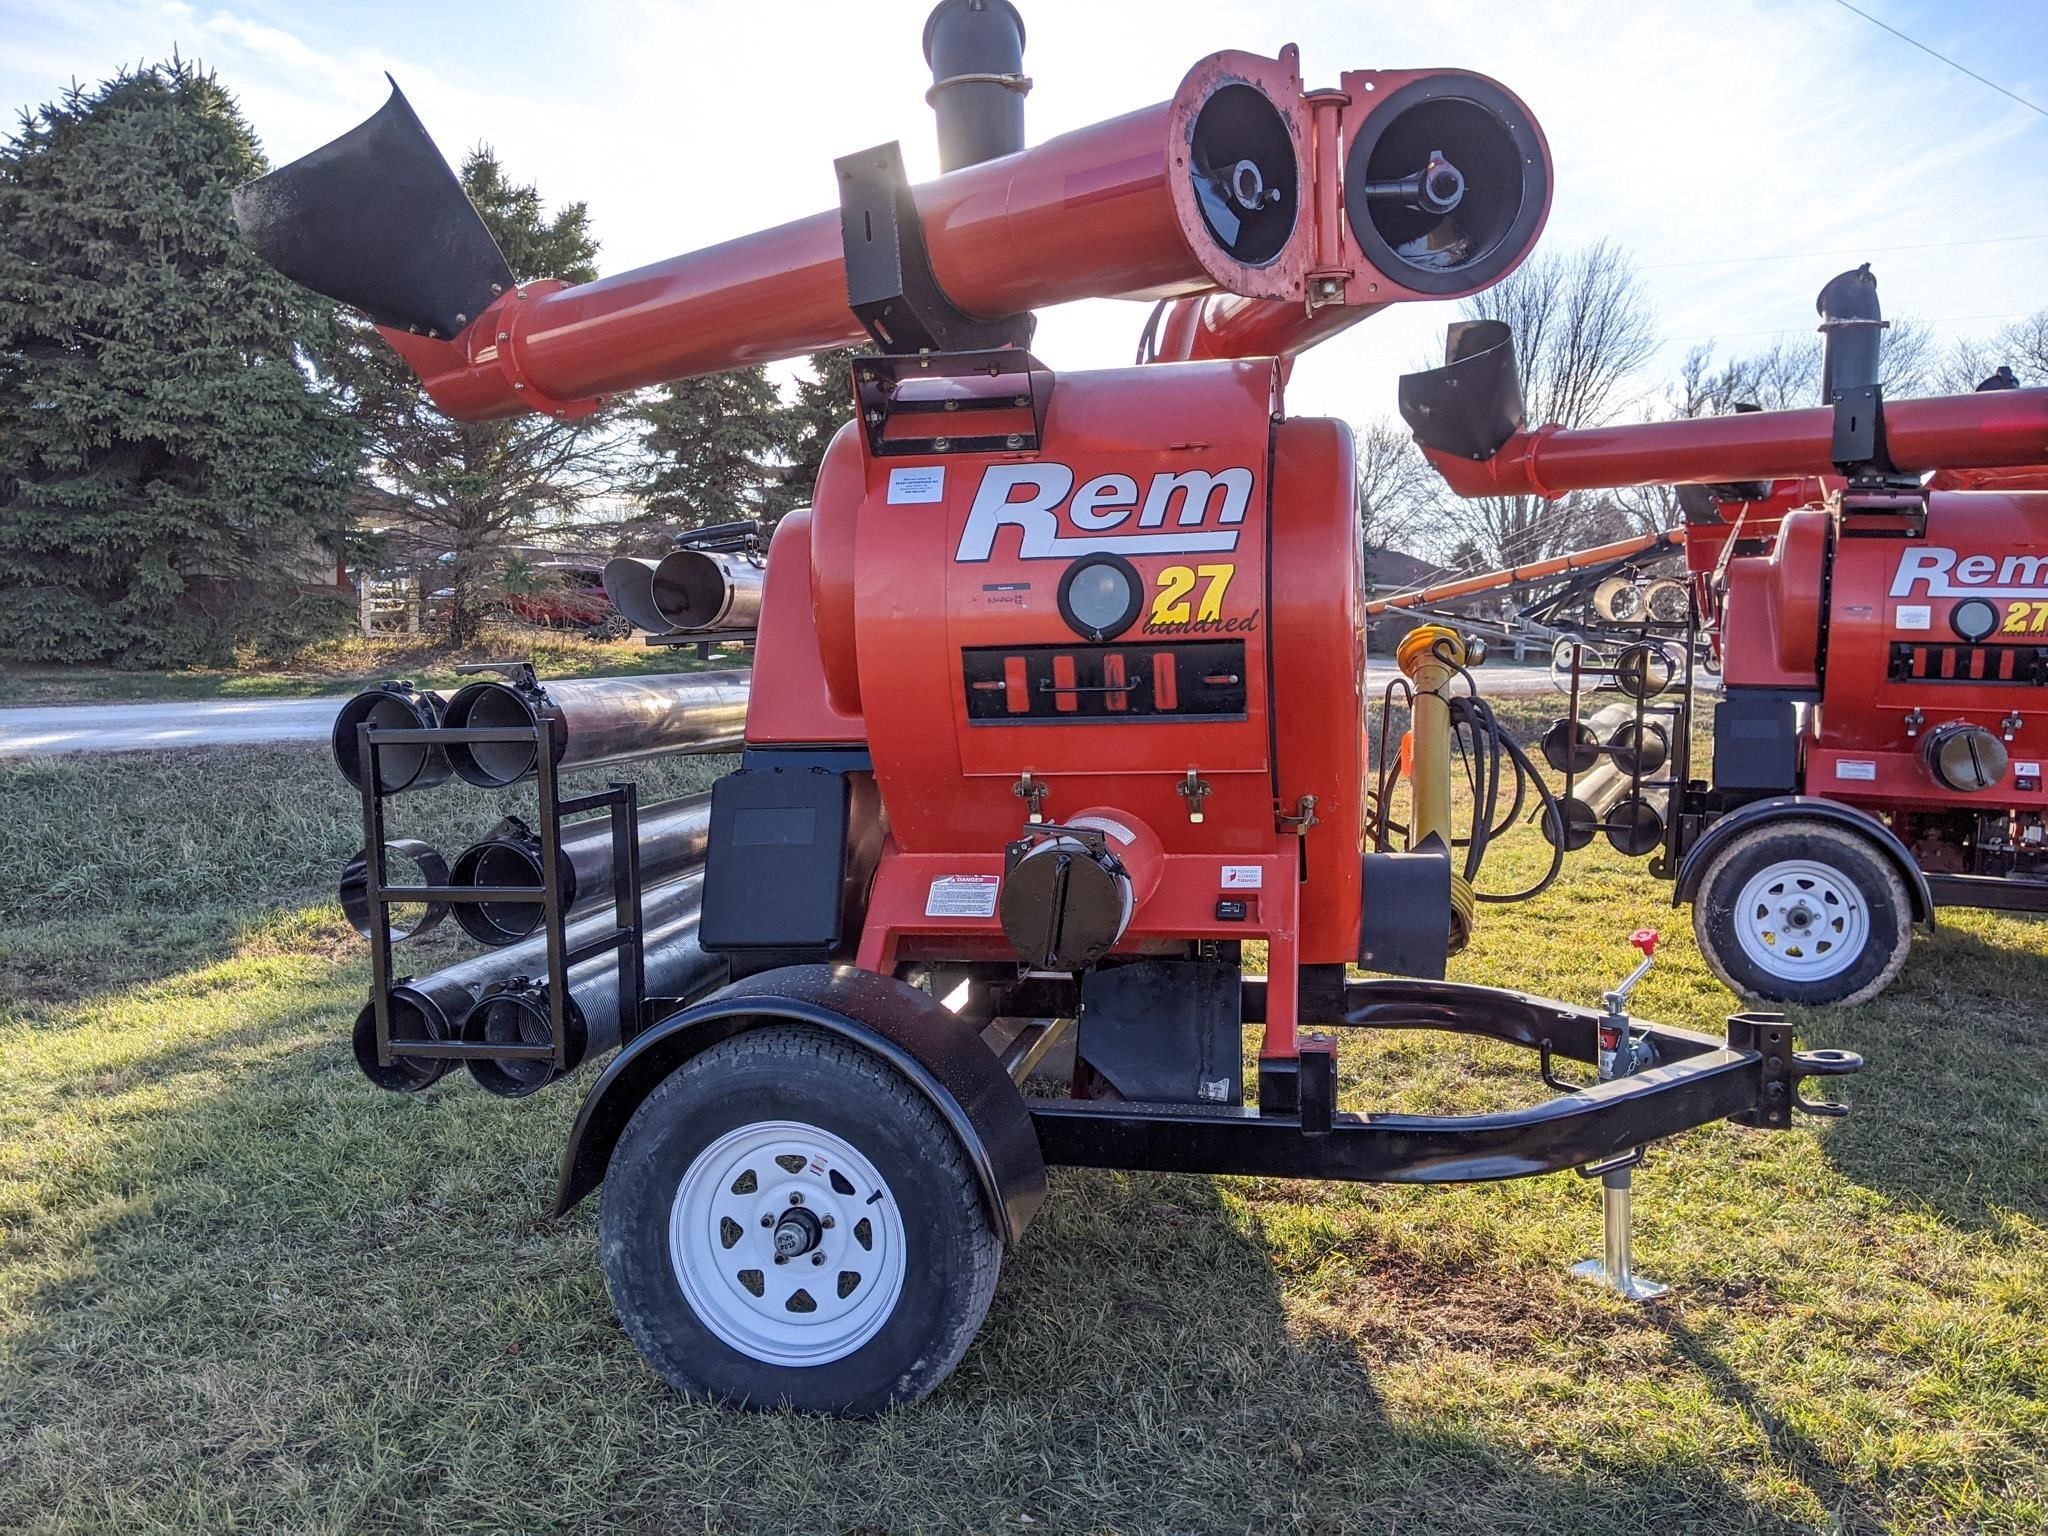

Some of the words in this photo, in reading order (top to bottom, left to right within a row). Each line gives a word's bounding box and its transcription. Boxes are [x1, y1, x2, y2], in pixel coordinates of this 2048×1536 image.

[953, 461, 1254, 563] Rem
[1150, 563, 1235, 626] 27
[2002, 601, 2048, 633] 27
[1142, 608, 1259, 636] hundred
